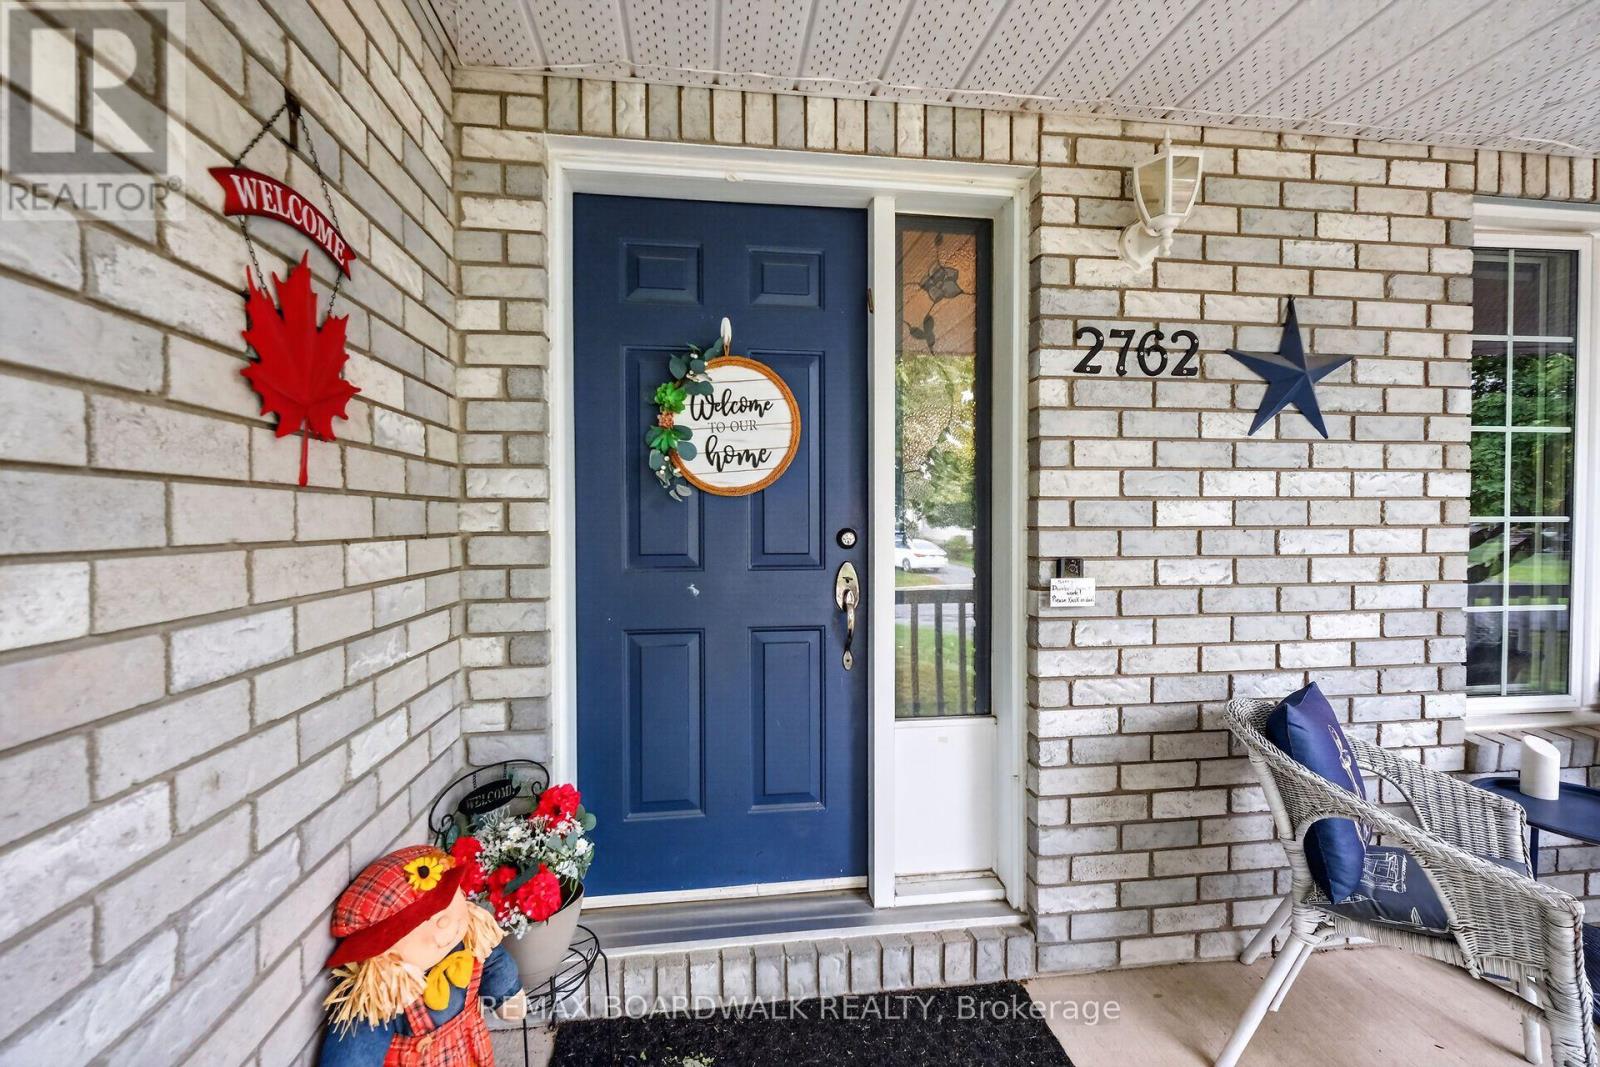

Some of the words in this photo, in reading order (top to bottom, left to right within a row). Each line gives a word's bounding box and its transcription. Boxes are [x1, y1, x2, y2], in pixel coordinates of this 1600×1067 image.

[229, 174, 346, 267] WELCOME
[1073, 326, 1200, 377] 2762
[690, 388, 774, 421] Welcome
[707, 422, 726, 434] TO
[729, 419, 758, 432] OUR
[705, 434, 772, 472] home
[466, 784, 516, 809] WELCOM
